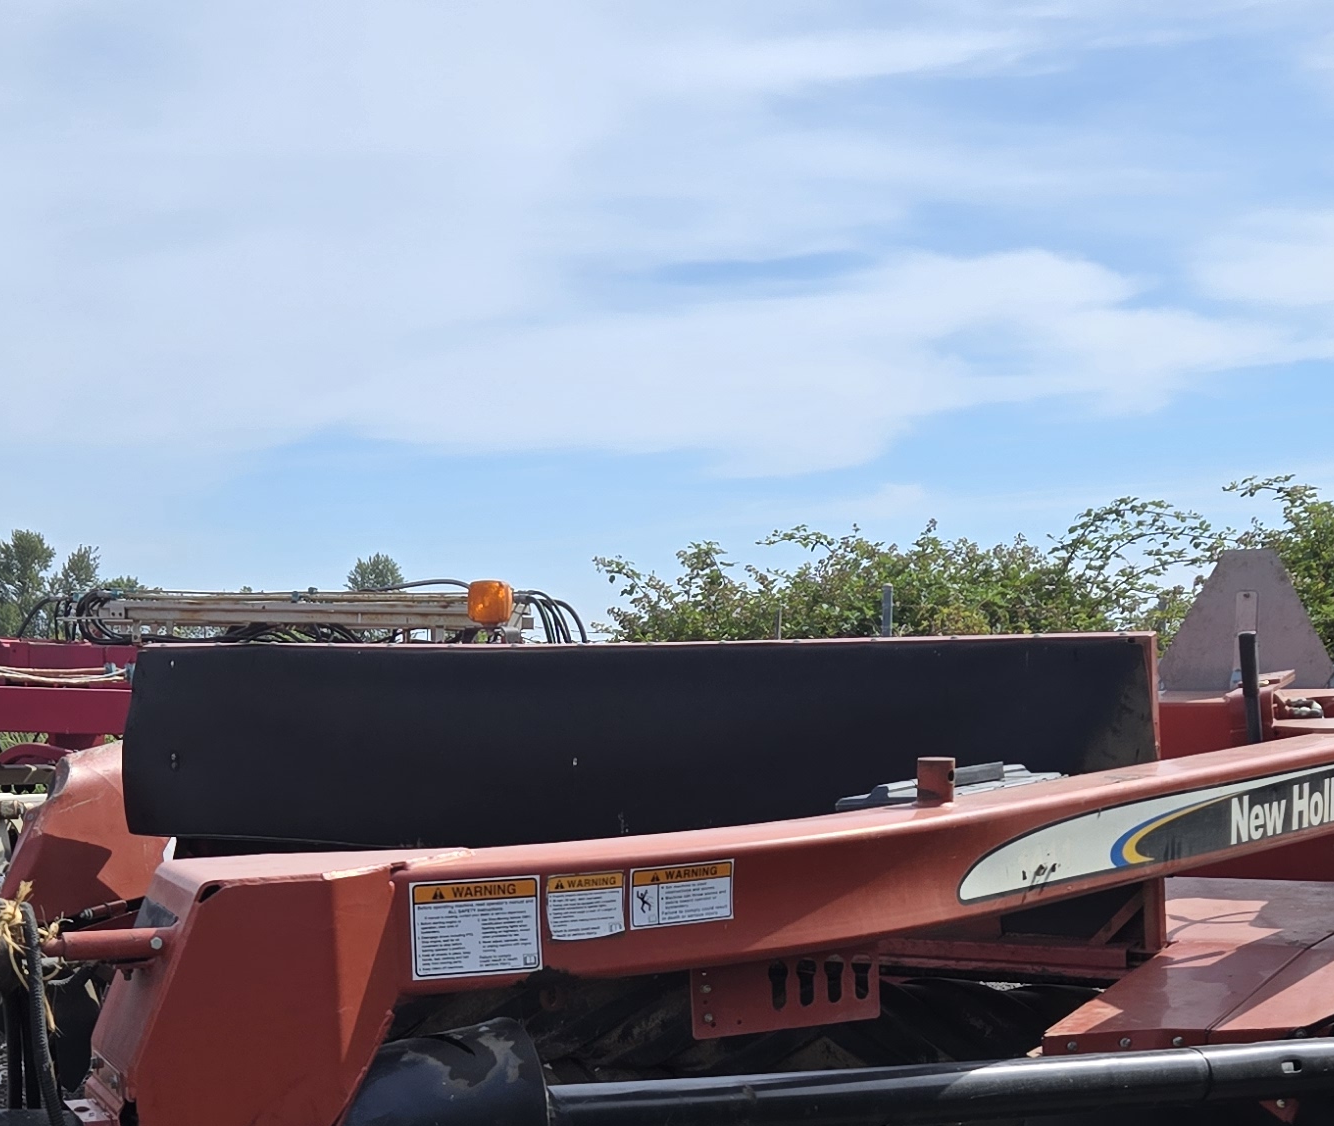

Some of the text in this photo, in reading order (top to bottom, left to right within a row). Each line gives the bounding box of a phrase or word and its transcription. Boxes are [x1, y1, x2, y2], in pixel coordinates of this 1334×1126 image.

[1230, 794, 1287, 845] New
[665, 866, 718, 880] WARNING
[567, 876, 616, 888] WARNING
[452, 883, 517, 898] WARNING
